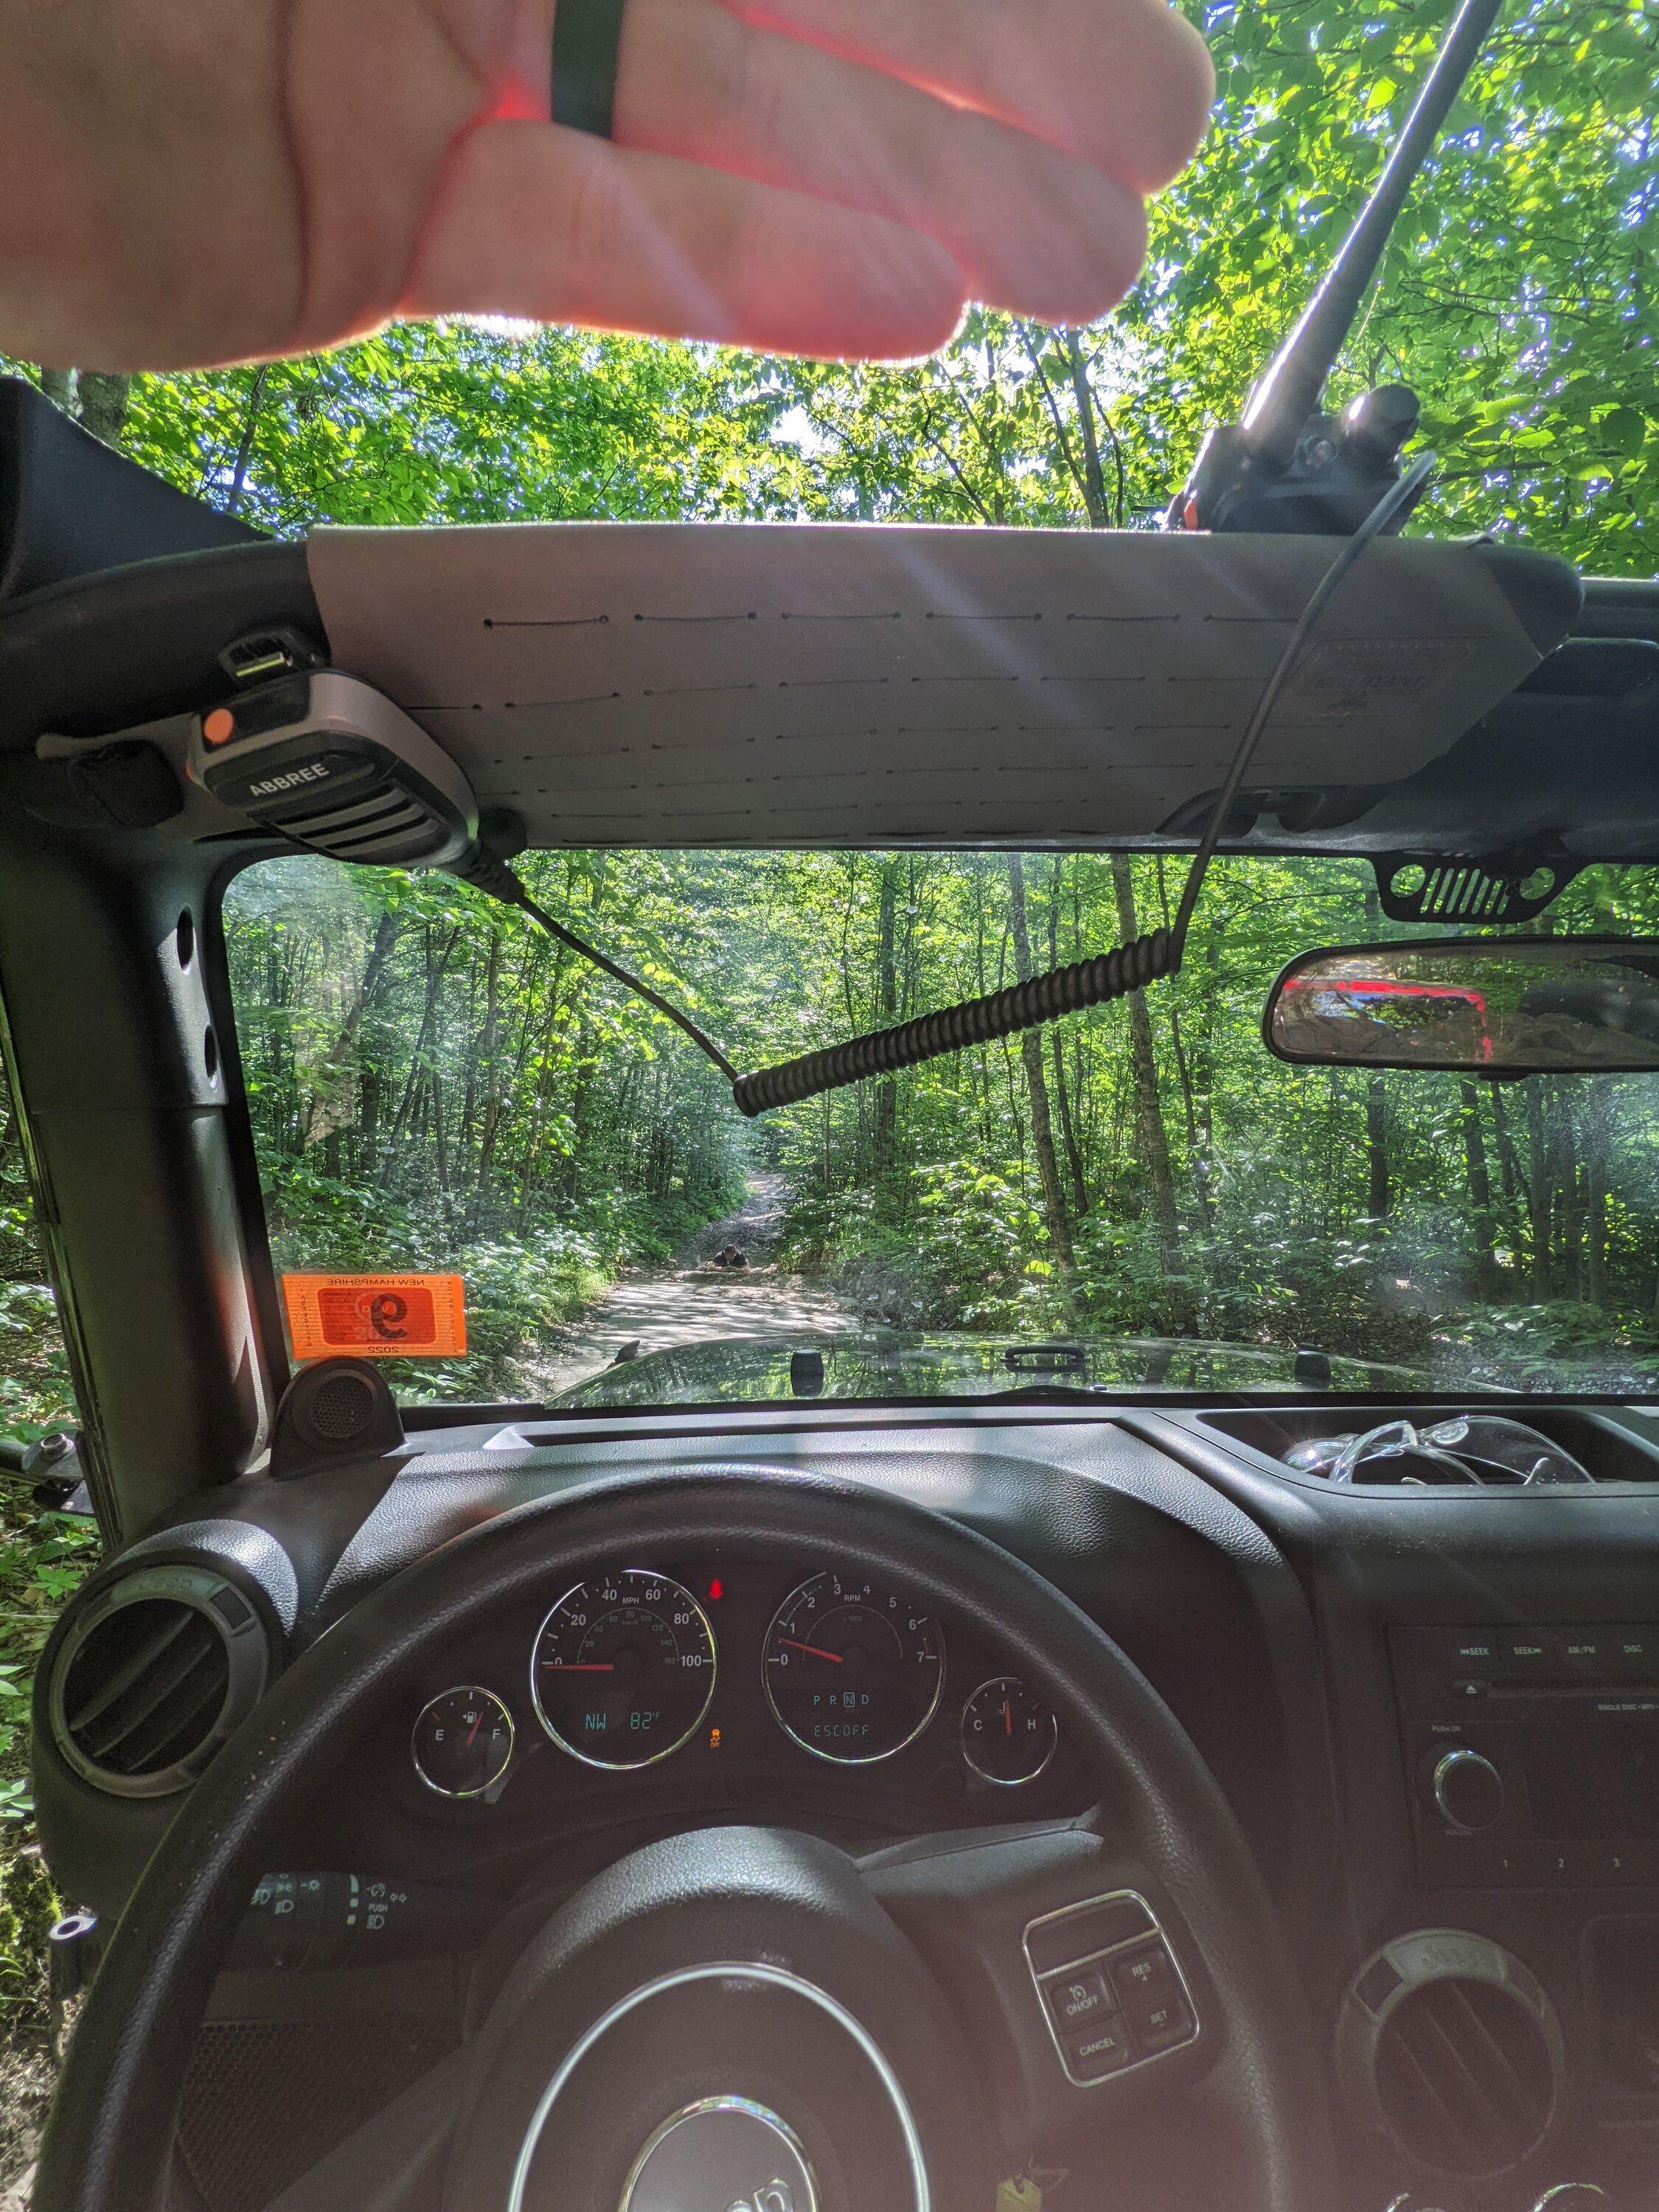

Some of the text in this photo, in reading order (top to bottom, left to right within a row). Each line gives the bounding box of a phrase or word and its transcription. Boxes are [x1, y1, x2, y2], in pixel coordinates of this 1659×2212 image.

[248, 762, 330, 797] ABBREE
[833, 1583, 841, 1595] 3
[863, 1585, 871, 1594] 4
[602, 1590, 617, 1601] 40
[622, 1596, 640, 1604] MPH
[644, 1590, 661, 1601] 60
[844, 1594, 861, 1602] RPM
[807, 1597, 815, 1608] 2
[888, 1597, 897, 1608] 5
[571, 1614, 587, 1626] 20
[673, 1613, 689, 1625] 80
[908, 1618, 917, 1631] 6
[790, 1623, 796, 1633] 1
[1624, 1644, 1643, 1653] DISC
[681, 1655, 701, 1667] 100
[780, 1655, 788, 1666] 0
[917, 1651, 925, 1663] 7
[813, 1694, 869, 1705] P R N D
[585, 1712, 607, 1730] NW
[973, 1719, 983, 1731] C
[1027, 1719, 1036, 1731] H
[435, 1730, 444, 1741] E
[492, 1728, 501, 1740] F
[1503, 1860, 1508, 1868] 1
[1558, 1858, 1564, 1868] 2
[1613, 1858, 1620, 1868] 3
[368, 1903, 389, 1913] PUSH
[1132, 1962, 1151, 1977] RES
[1066, 1995, 1099, 2016] ON/OFF
[1150, 2009, 1167, 2023] SET
[1079, 2037, 1116, 2056] CANCEL
